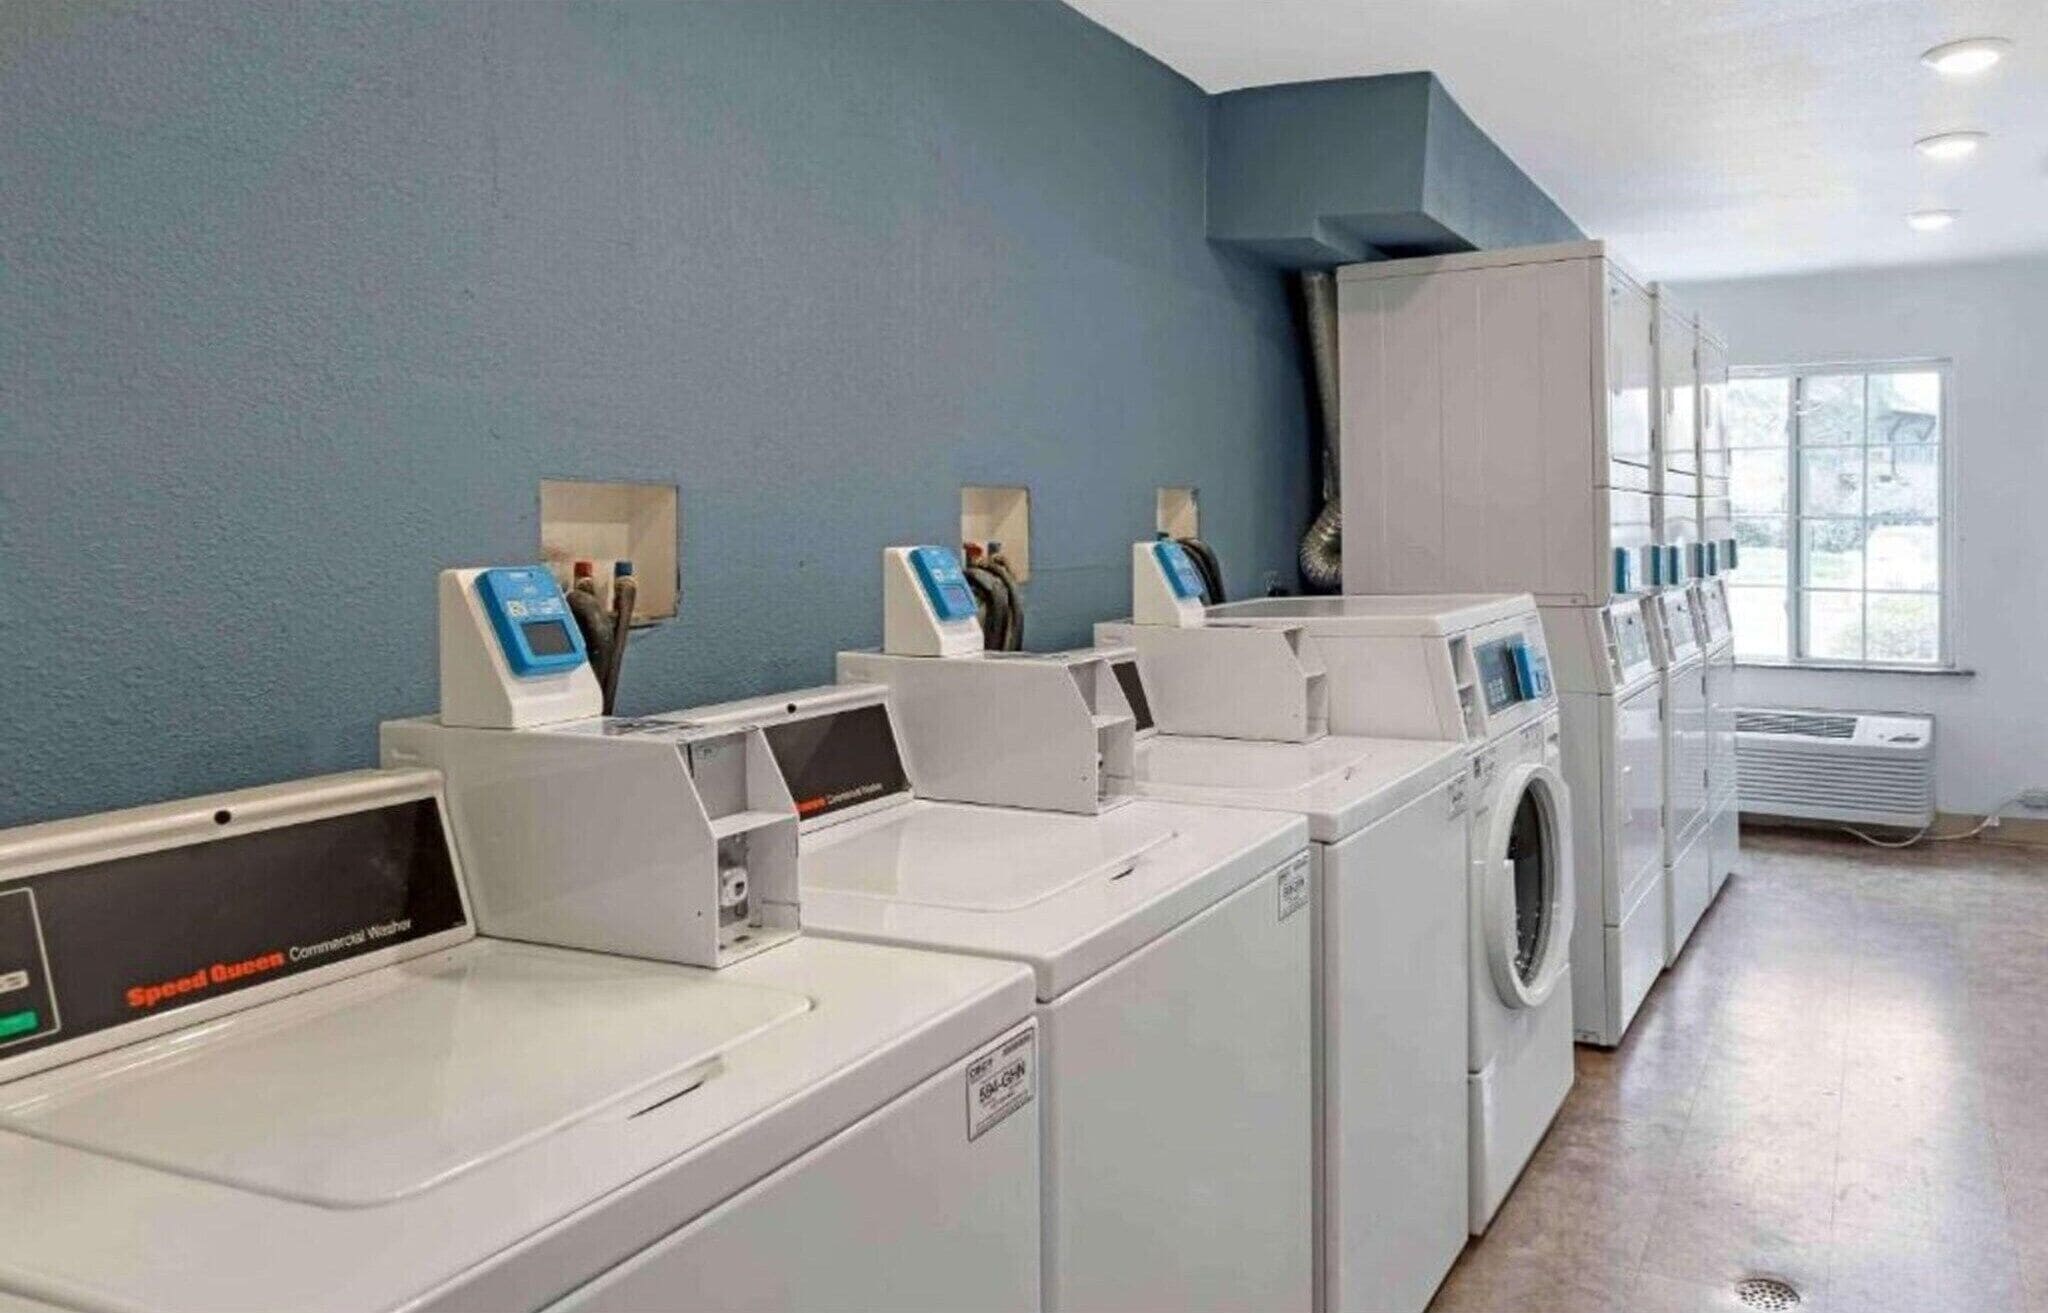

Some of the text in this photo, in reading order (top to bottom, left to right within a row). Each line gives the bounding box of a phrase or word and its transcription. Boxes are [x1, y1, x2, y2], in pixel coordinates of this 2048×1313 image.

[127, 919, 411, 1007] Speed Queen Commercial Washer
